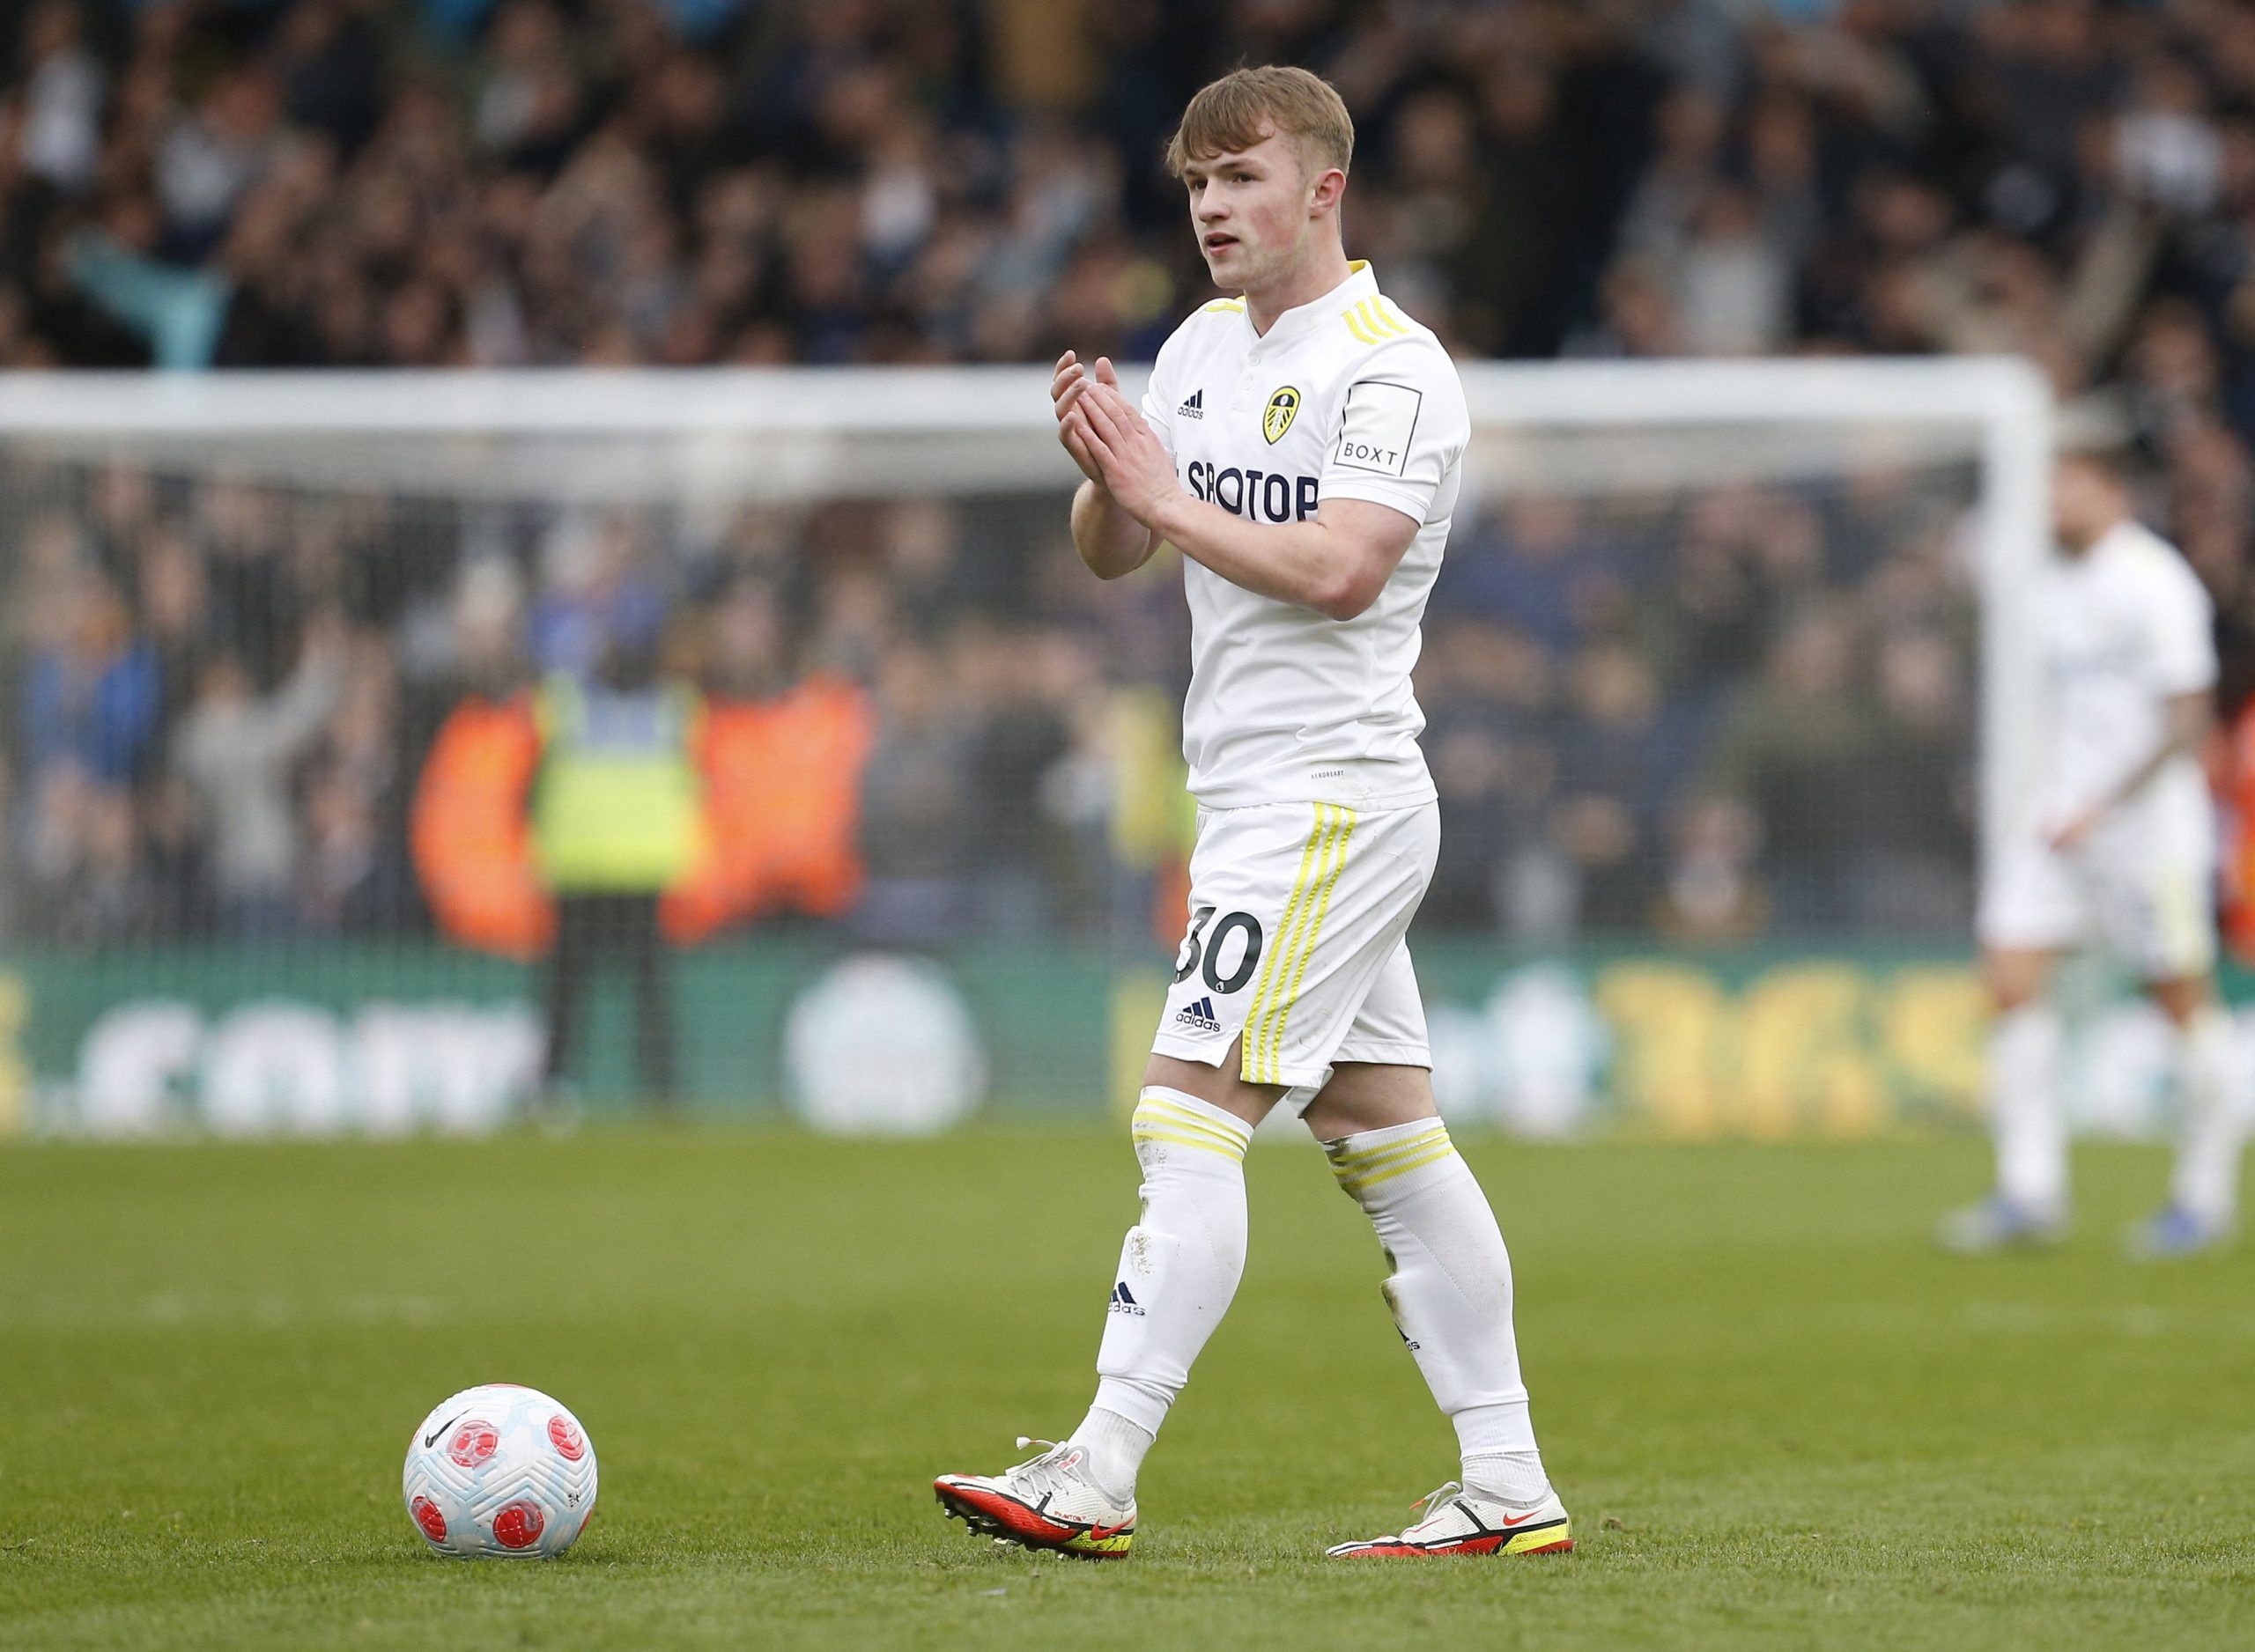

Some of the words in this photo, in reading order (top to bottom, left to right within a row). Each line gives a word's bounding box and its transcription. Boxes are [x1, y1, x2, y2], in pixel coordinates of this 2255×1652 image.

[1177, 405, 1204, 420] adidas
[1343, 441, 1399, 466] BOXT
[1175, 906, 1263, 995] 30
[1175, 1011, 1222, 1033] adidas
